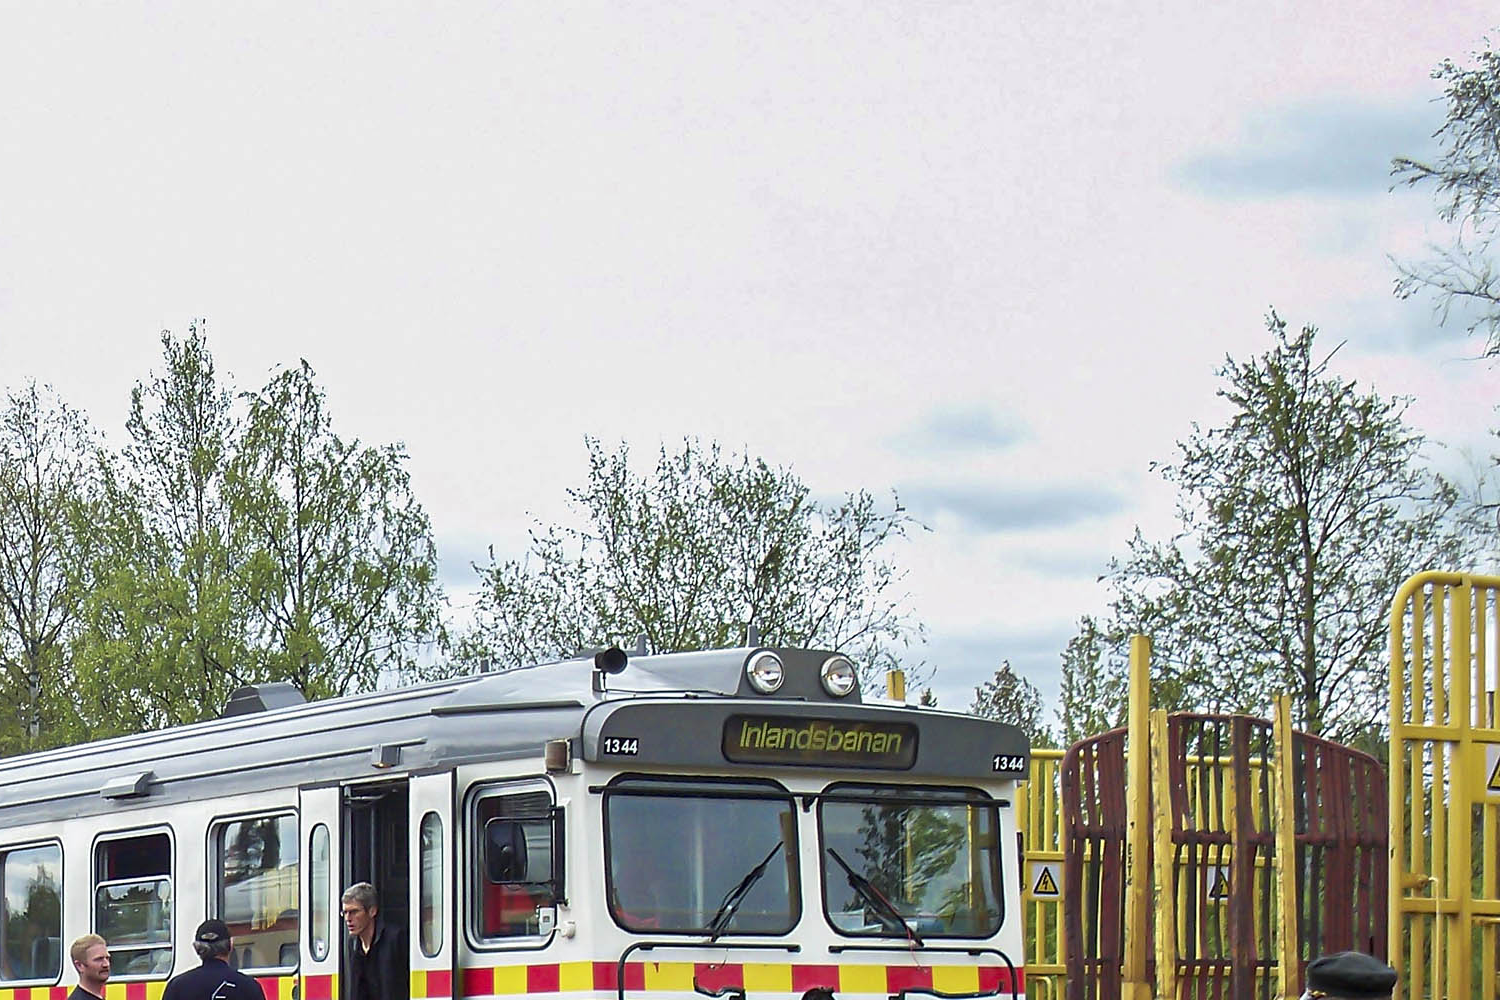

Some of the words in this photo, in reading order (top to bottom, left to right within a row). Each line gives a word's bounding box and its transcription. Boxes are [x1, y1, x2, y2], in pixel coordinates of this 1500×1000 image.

[739, 720, 902, 753] Inlandsbanan
[604, 738, 638, 754] 1344
[993, 756, 1024, 771] 1344
